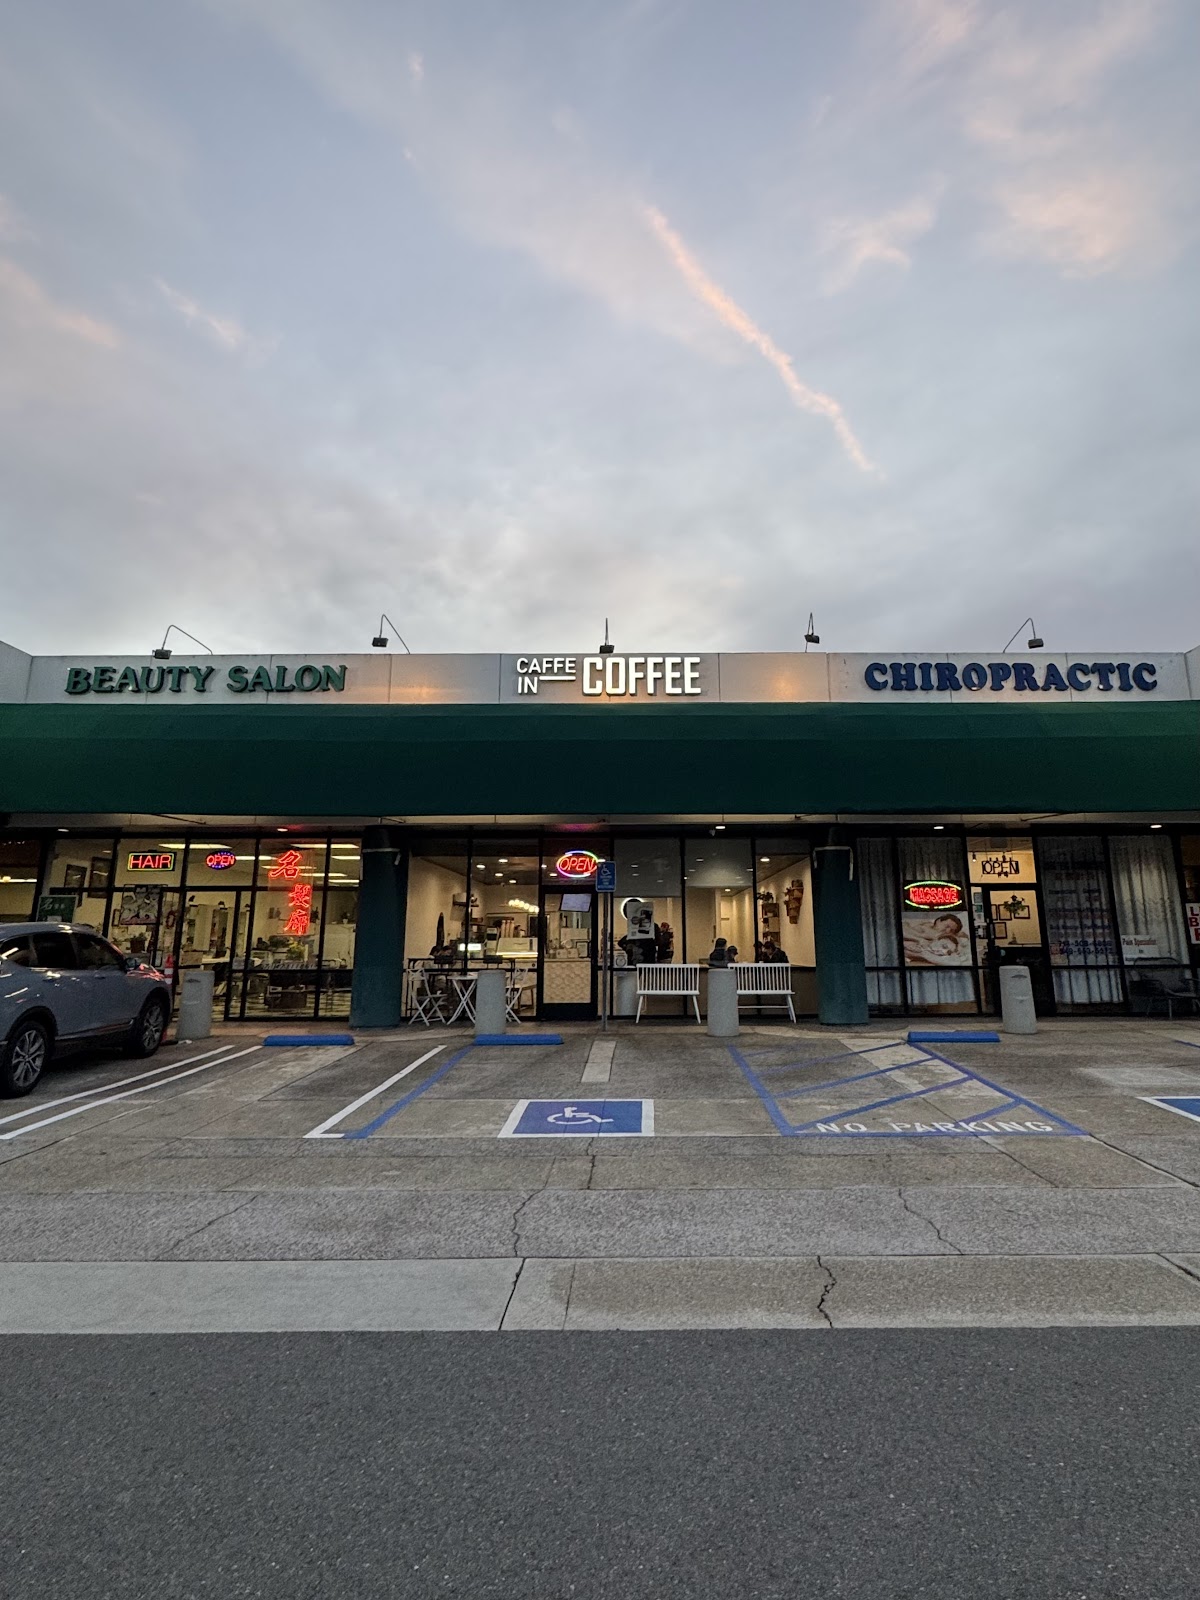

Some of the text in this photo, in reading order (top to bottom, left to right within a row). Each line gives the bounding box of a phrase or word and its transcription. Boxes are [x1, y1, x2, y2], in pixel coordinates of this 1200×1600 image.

[516, 657, 577, 674] CAFFE
[65, 665, 347, 694] BEAUTY SALON
[582, 656, 702, 695] COFFEE
[864, 662, 1158, 691] CHIROPRACTIC
[517, 676, 538, 694] IN
[130, 854, 171, 869] HAIR
[206, 854, 235, 866] OPEN
[559, 857, 595, 871] OPEN
[983, 860, 1019, 874] OPEN
[909, 887, 959, 903] MASSAGE
[816, 1121, 1053, 1133] NO PARKING
